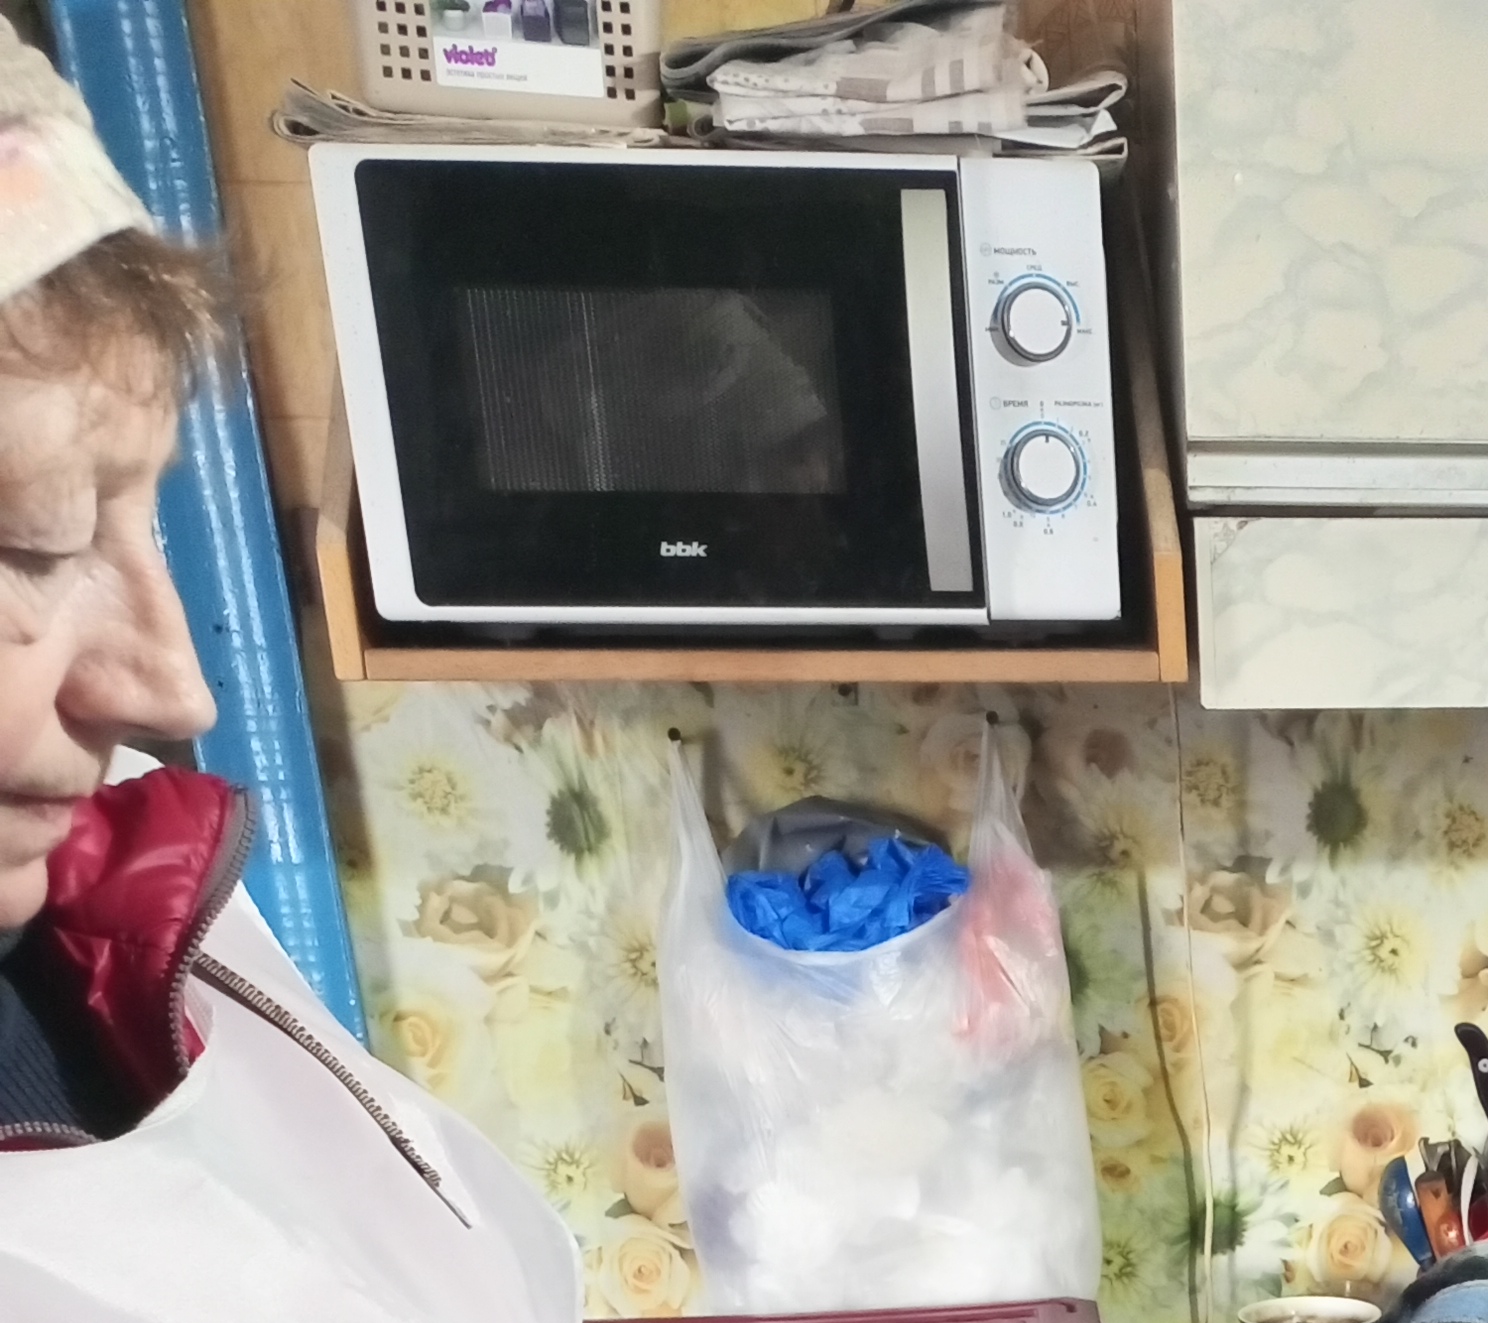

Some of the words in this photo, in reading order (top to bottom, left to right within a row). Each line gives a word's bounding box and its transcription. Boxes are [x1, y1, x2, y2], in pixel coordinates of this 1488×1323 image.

[994, 247, 1037, 256] МОЩНОСТЬ
[1003, 400, 1028, 408] ВРЕМЯ
[660, 541, 708, 557] bbk
